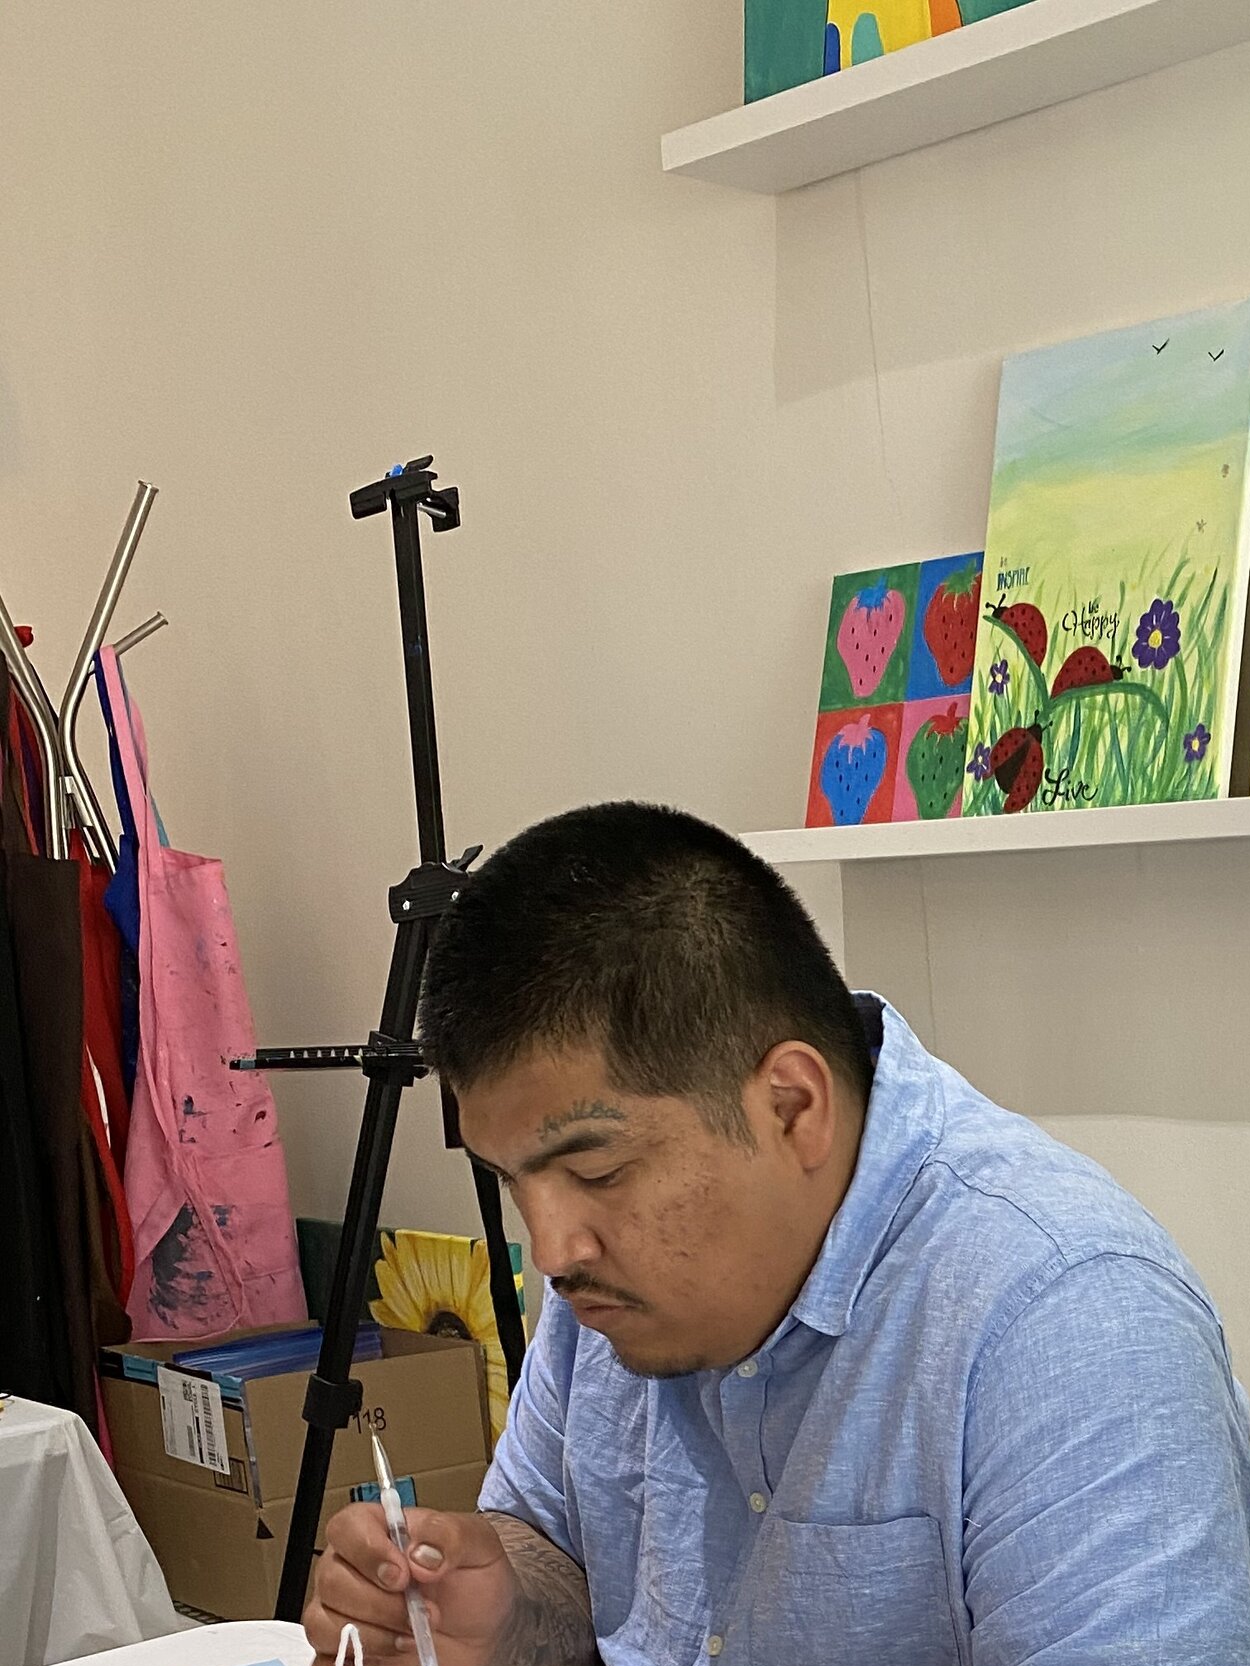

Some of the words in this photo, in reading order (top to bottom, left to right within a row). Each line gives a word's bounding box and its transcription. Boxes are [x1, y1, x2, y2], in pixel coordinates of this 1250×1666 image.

[1062, 606, 1120, 641] Happy
[1088, 600, 1099, 614] be
[1042, 767, 1099, 807] Live
